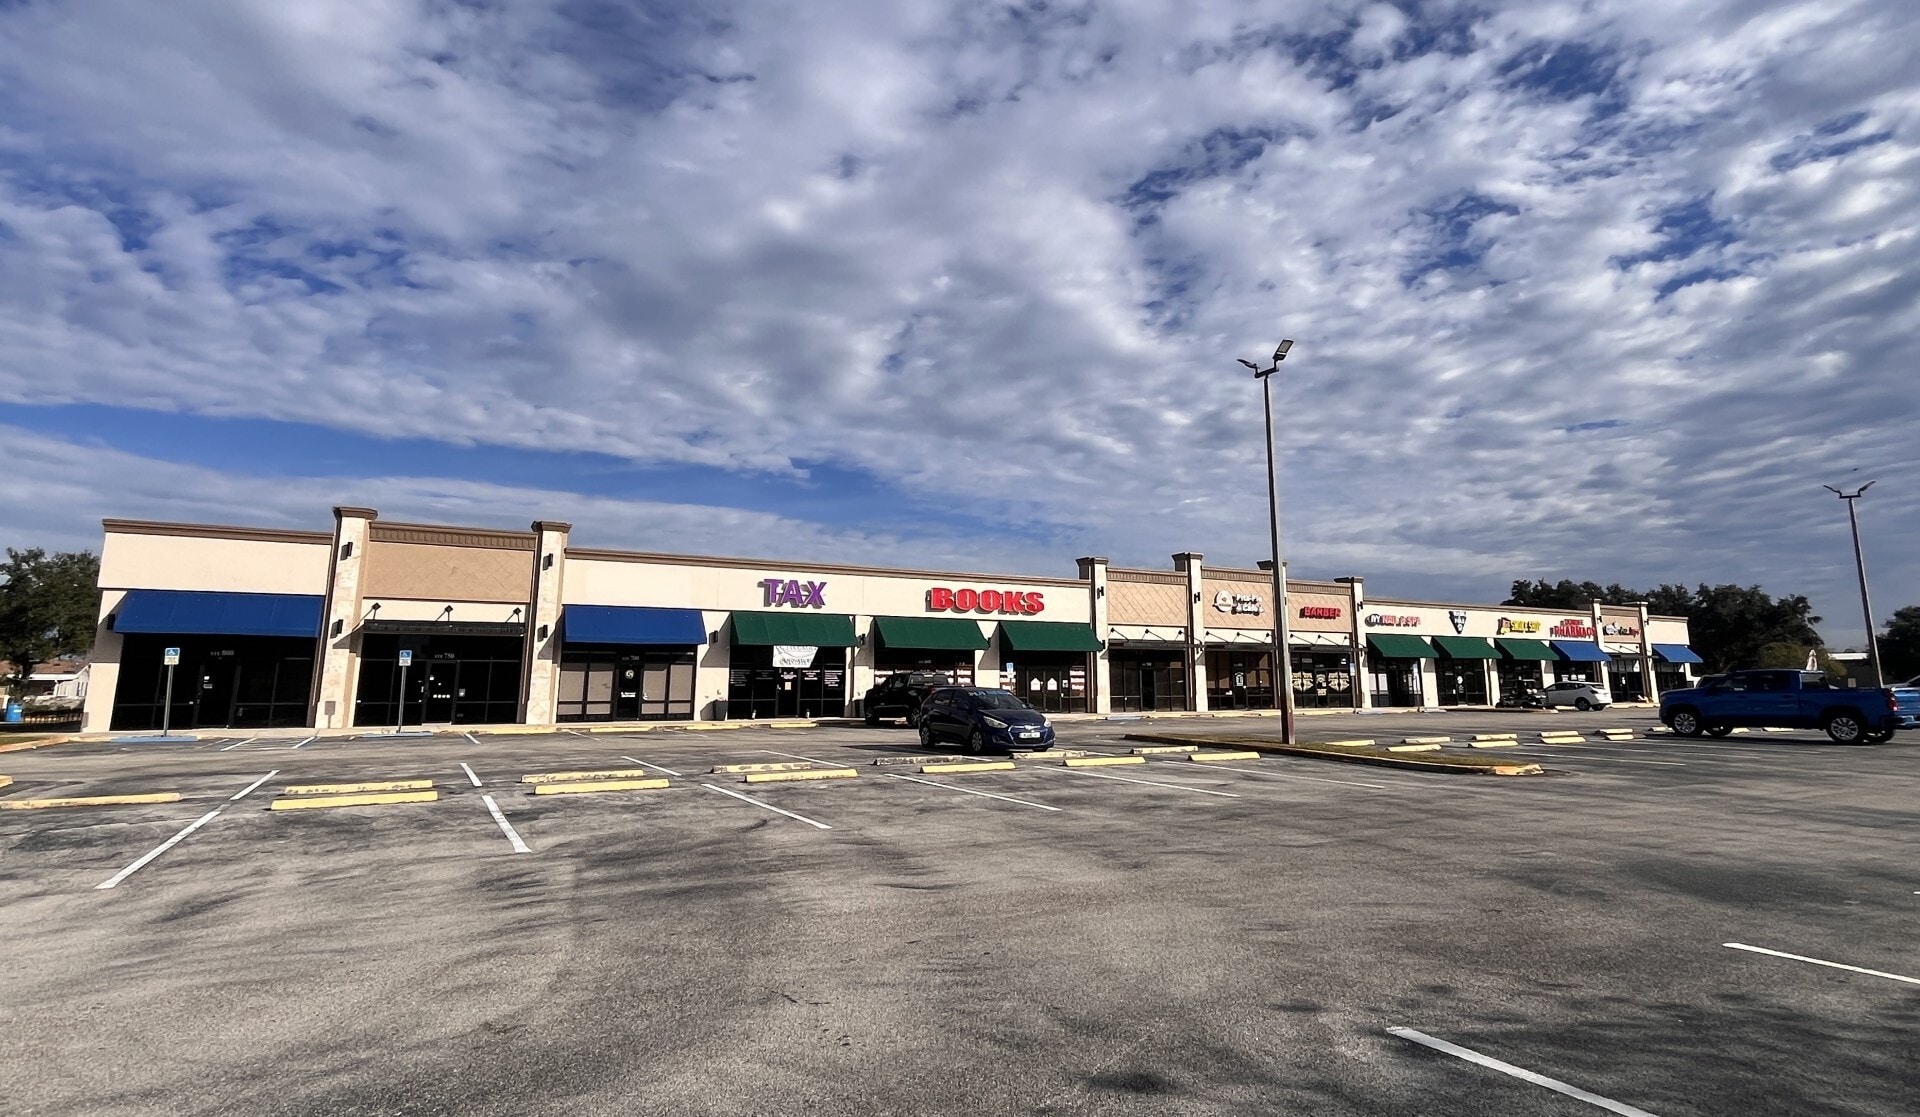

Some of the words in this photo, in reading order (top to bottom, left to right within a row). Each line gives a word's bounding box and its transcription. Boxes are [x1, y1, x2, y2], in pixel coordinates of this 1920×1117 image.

[763, 578, 827, 605] TAX
[931, 587, 1045, 613] BOOKS
[1304, 606, 1341, 618] BARBER
[1554, 625, 1597, 638] PHARMACY
